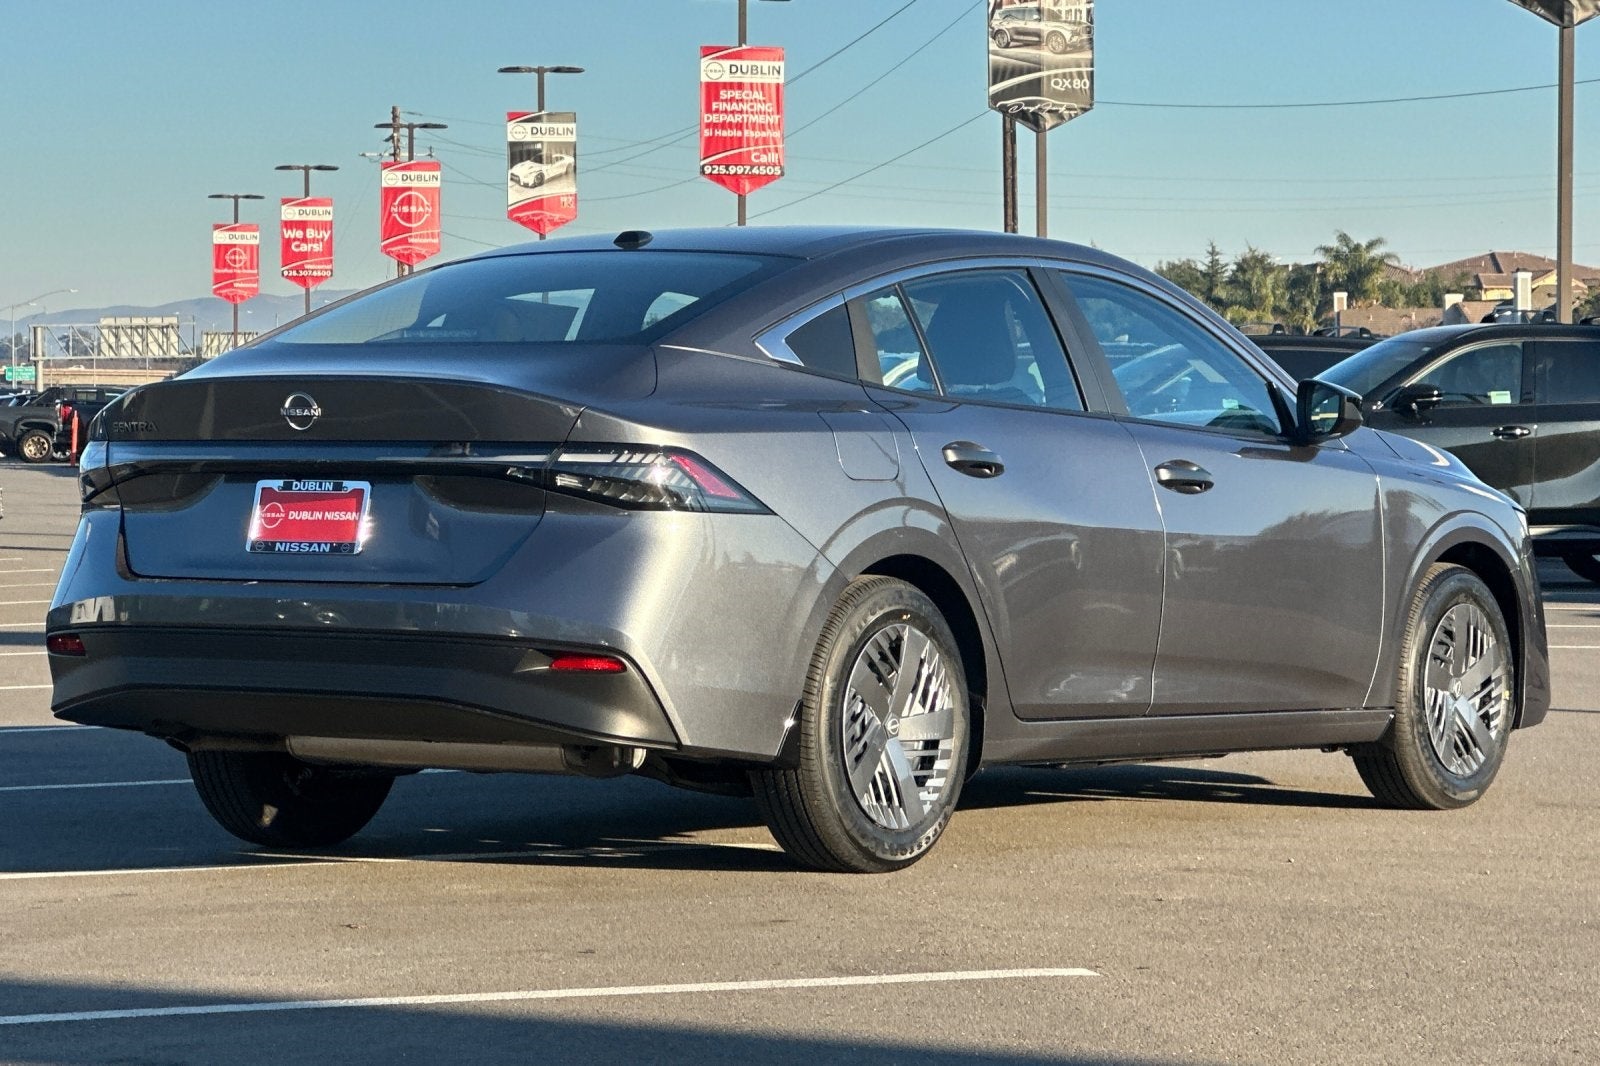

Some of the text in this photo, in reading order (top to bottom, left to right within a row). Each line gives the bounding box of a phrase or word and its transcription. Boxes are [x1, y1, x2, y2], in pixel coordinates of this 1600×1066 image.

[729, 64, 781, 76] DUBLIN
[1051, 78, 1090, 91] QX80
[719, 90, 765, 100] SPECIAL
[712, 102, 773, 113] FINANCING
[704, 113, 781, 124] DEPARTMENT
[530, 126, 574, 136] DUBLIN
[714, 128, 742, 137] Habla
[751, 152, 780, 163] Call!
[703, 165, 781, 175] 925.997.4505
[401, 173, 439, 182] DUBLIN
[298, 208, 331, 216] DUBLIN
[391, 205, 432, 213] NISSAN
[228, 233, 258, 241] DUBLIN
[283, 228, 331, 241] We Buy
[291, 241, 323, 252] Cars!
[280, 407, 322, 417] NISSAN
[112, 420, 159, 433] SENTRA
[291, 480, 334, 491] DUBLIN
[288, 510, 323, 520] DUBLIN
[324, 511, 360, 521] NISSAN
[275, 542, 331, 553] NISSAN
